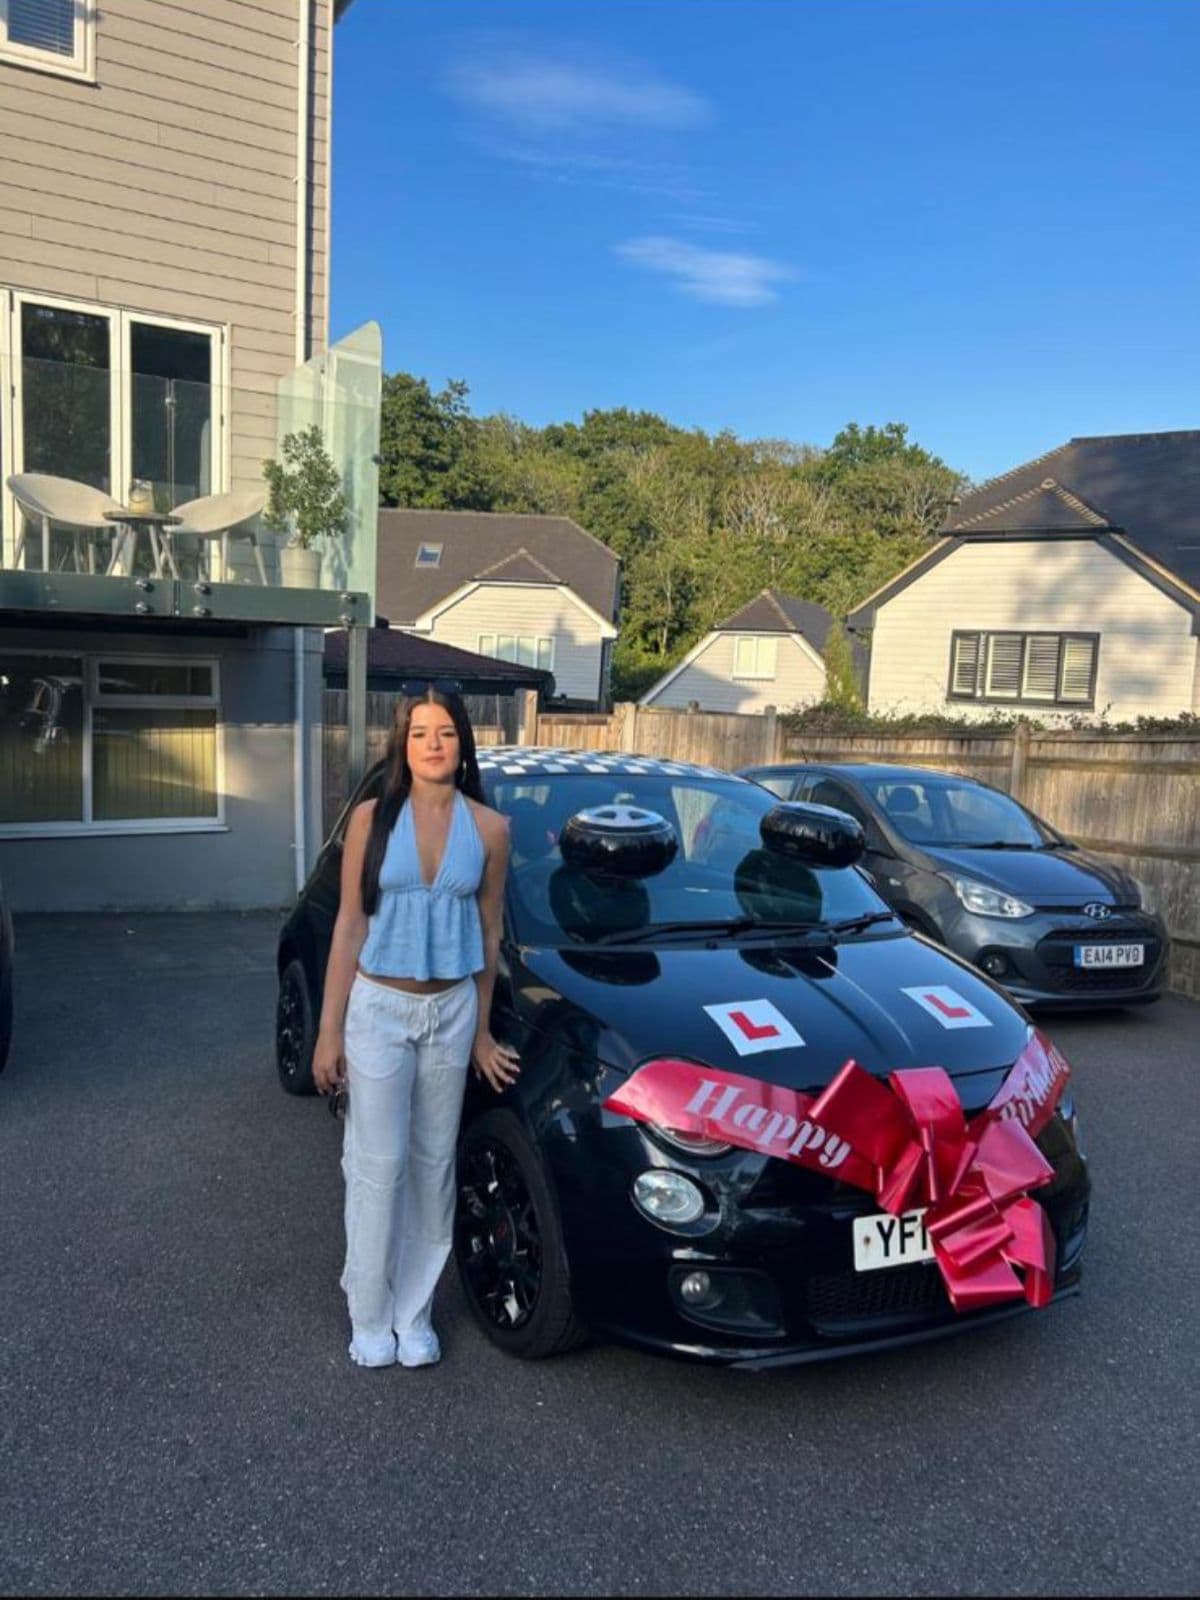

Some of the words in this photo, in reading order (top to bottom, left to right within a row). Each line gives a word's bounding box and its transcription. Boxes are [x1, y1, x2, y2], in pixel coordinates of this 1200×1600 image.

[1084, 948, 1113, 964] EA14
[923, 993, 972, 1018] L
[728, 1011, 780, 1040] L
[685, 1079, 851, 1168] Happy
